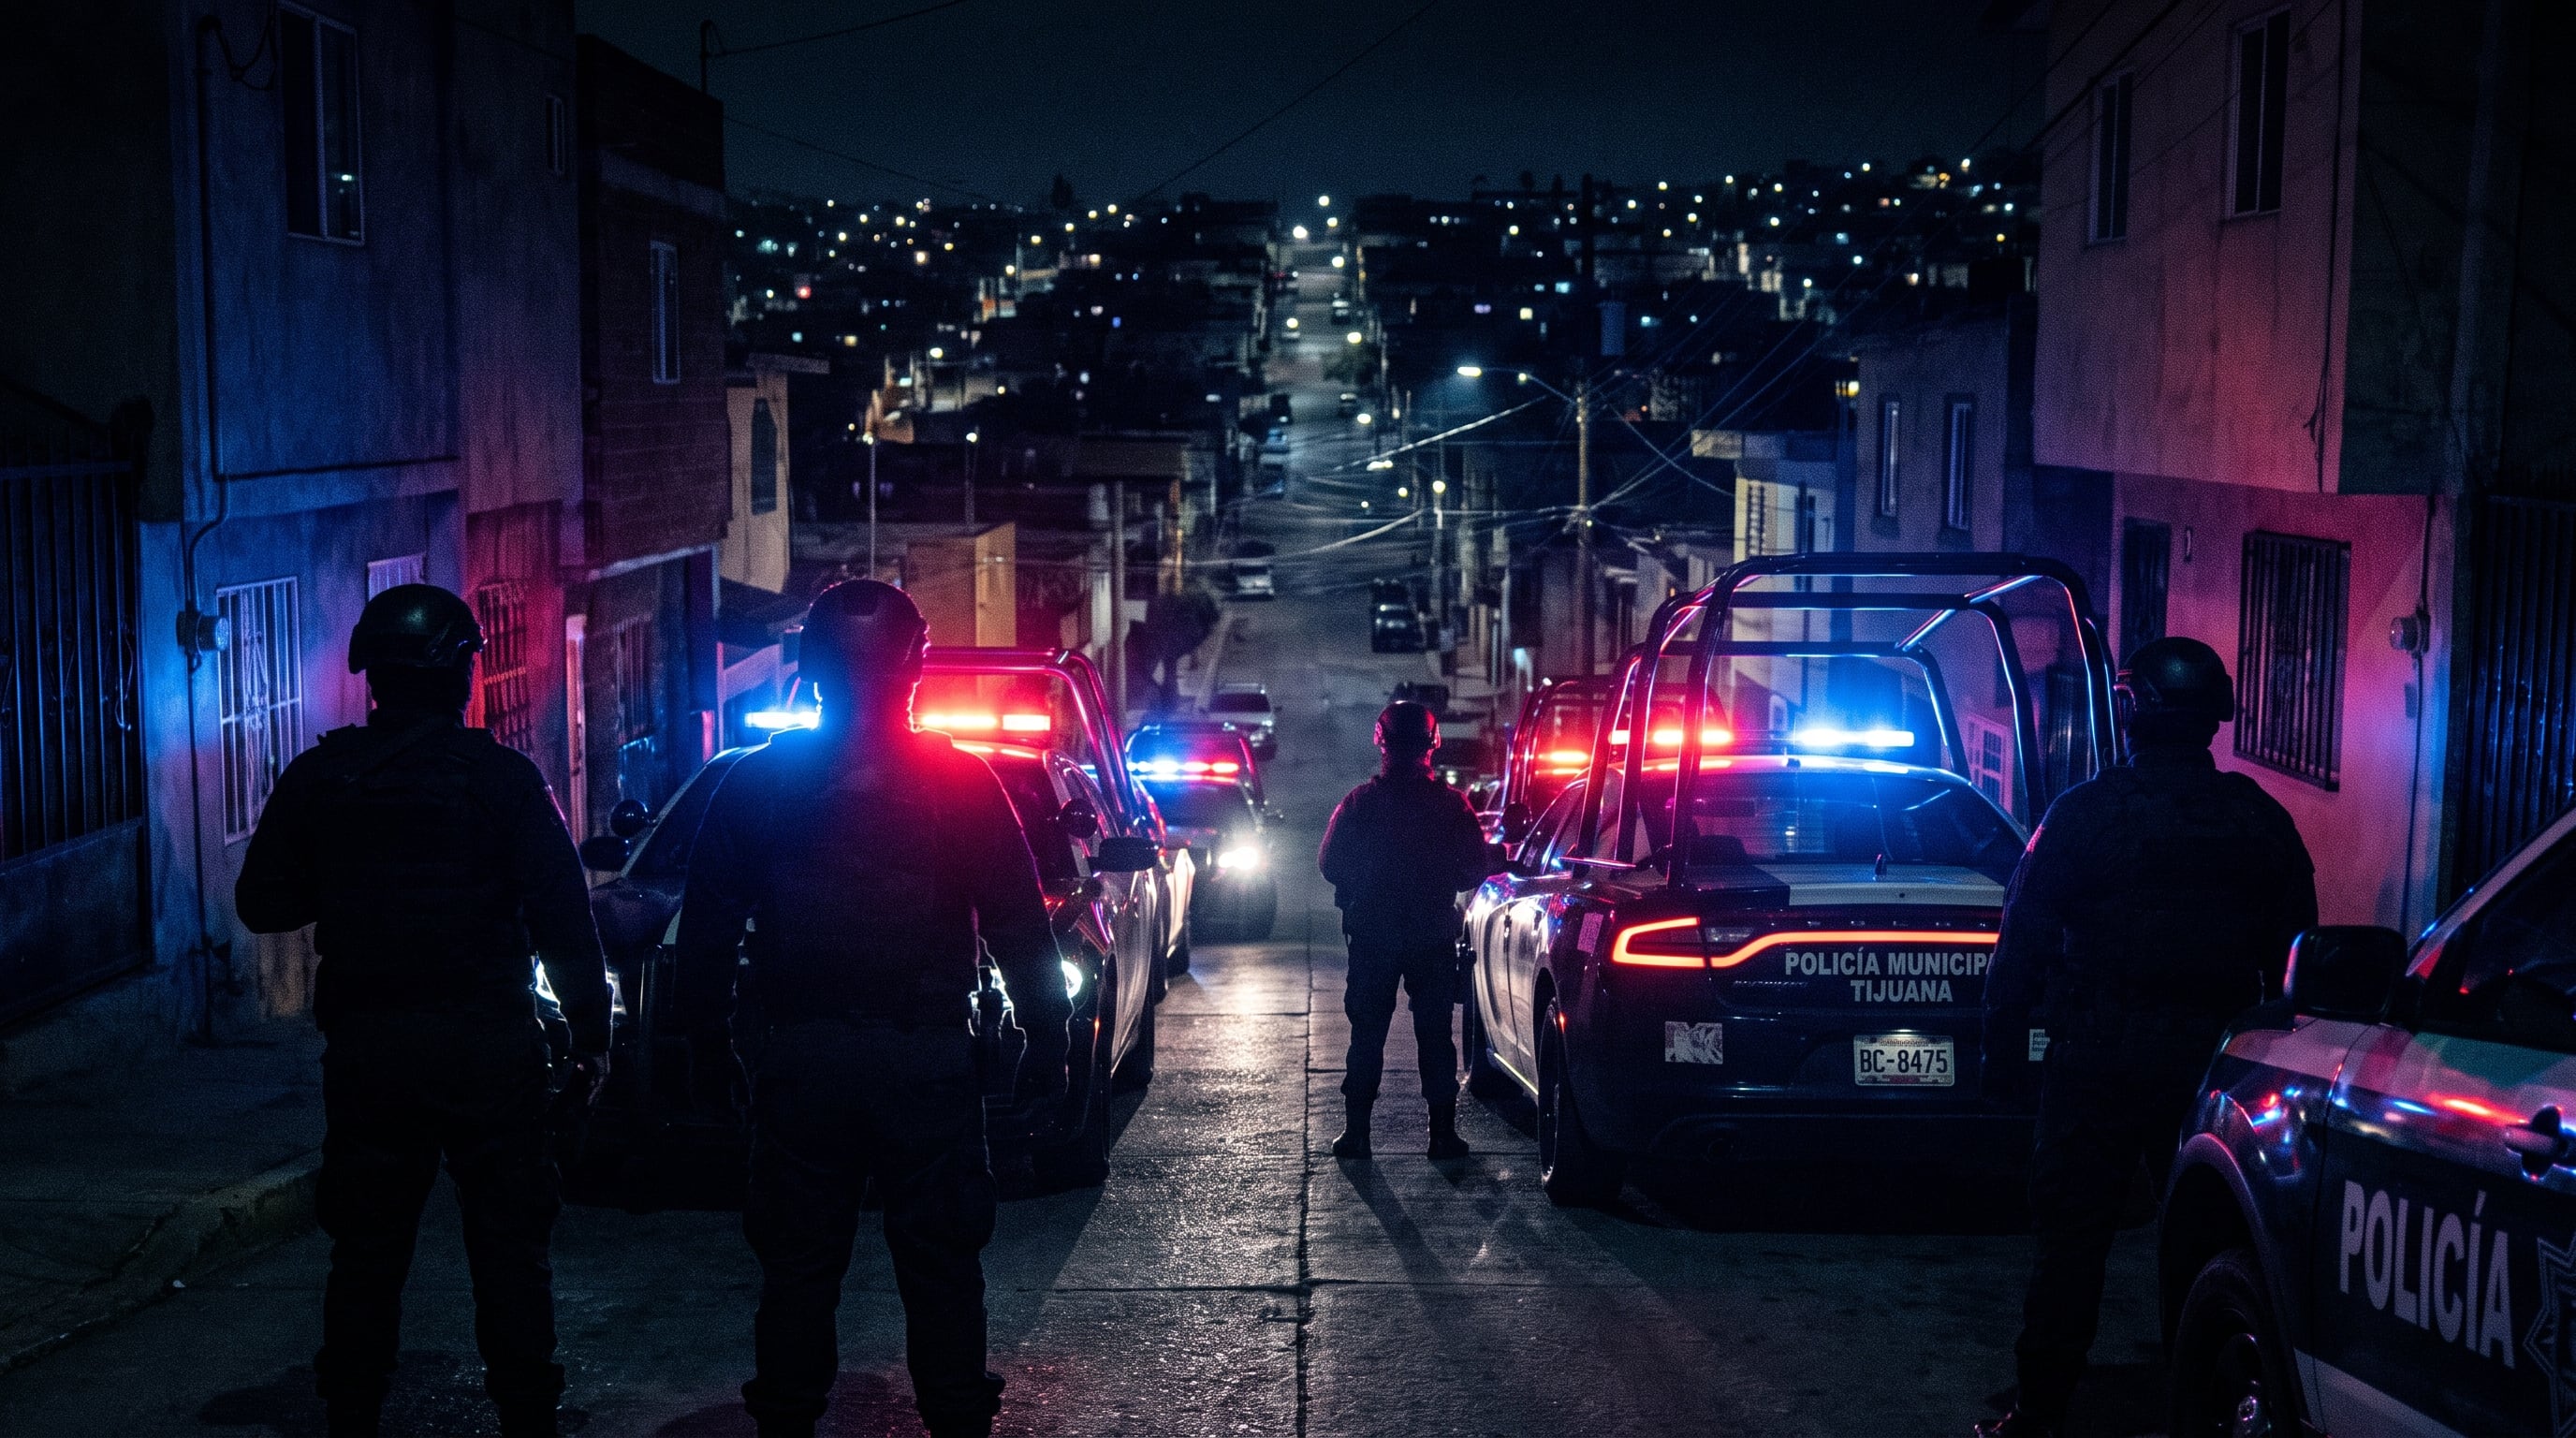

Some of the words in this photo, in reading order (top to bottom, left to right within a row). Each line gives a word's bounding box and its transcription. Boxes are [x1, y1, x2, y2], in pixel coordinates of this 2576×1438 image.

[1785, 946, 1881, 976] POLICÍA
[1887, 952, 1995, 976] MUNICIP
[1850, 979, 1954, 1003] TIJUANA
[1860, 1049, 1948, 1073] BC-8475
[2340, 1180, 2515, 1370] POLICÍA
